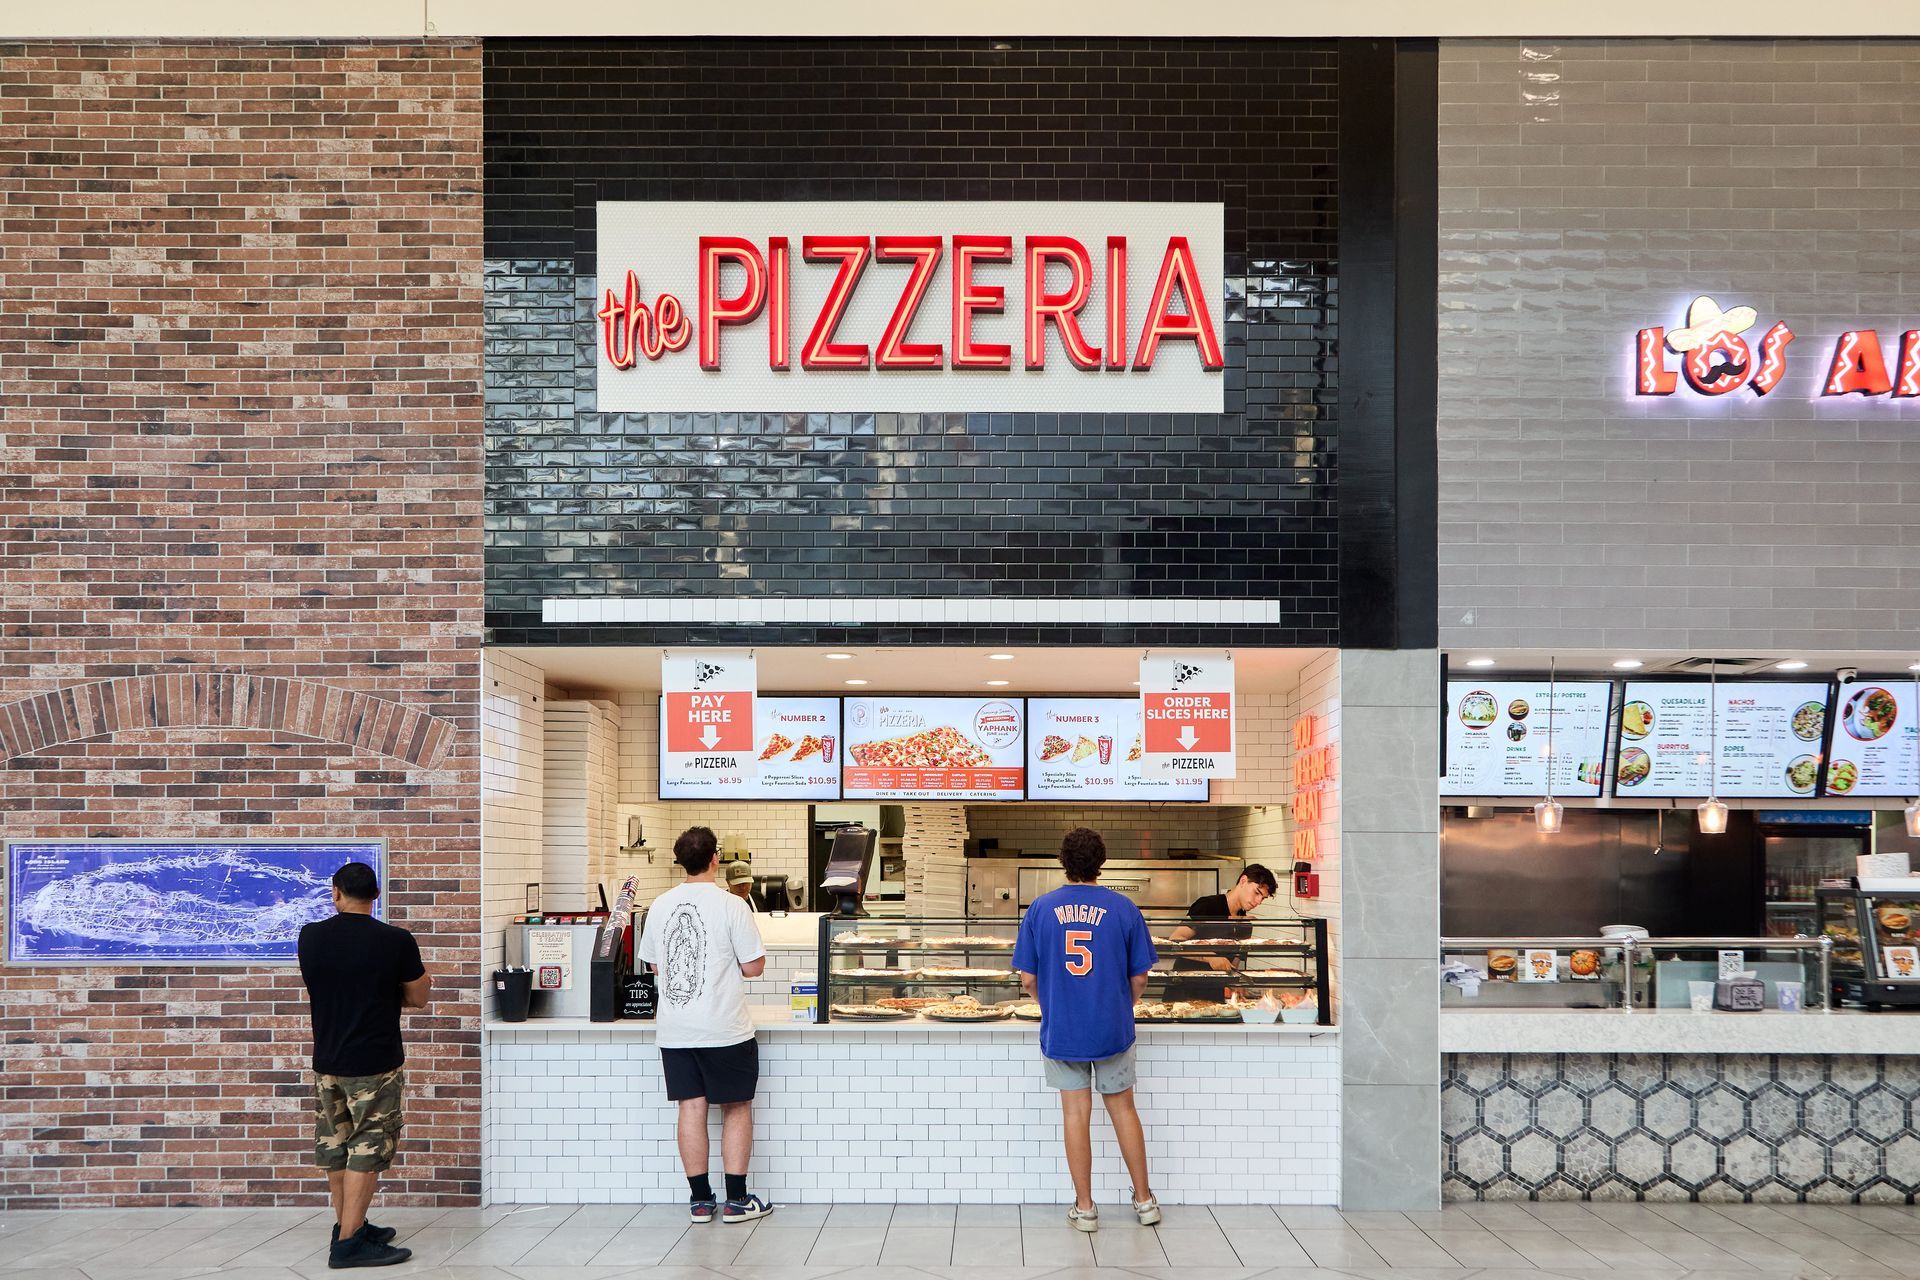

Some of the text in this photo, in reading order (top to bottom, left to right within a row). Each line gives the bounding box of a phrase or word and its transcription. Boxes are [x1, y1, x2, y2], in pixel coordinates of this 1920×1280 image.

[598, 236, 1224, 372] the PIZZERIA
[1636, 320, 1795, 397] LOS
[691, 695, 725, 708] PAY
[1164, 697, 1211, 708] ORDER
[688, 710, 731, 723] HERE
[780, 714, 818, 723] NUMBER
[1056, 715, 1093, 723] NUMBER
[1094, 715, 1100, 723] 3
[1146, 709, 1191, 719] SLICES
[1194, 709, 1229, 719] HERE
[879, 714, 926, 727] PIZZERIA
[695, 757, 737, 769] PIZZERIA
[1172, 758, 1215, 769] PIZZERIA
[718, 776, 742, 784] $8.95
[808, 777, 837, 785] $10.95
[1084, 777, 1114, 785] $10.95
[1175, 777, 1203, 785] $11.95
[1054, 904, 1107, 926] WRIGHT
[1065, 930, 1093, 976] 5
[629, 989, 649, 999] TIPS
